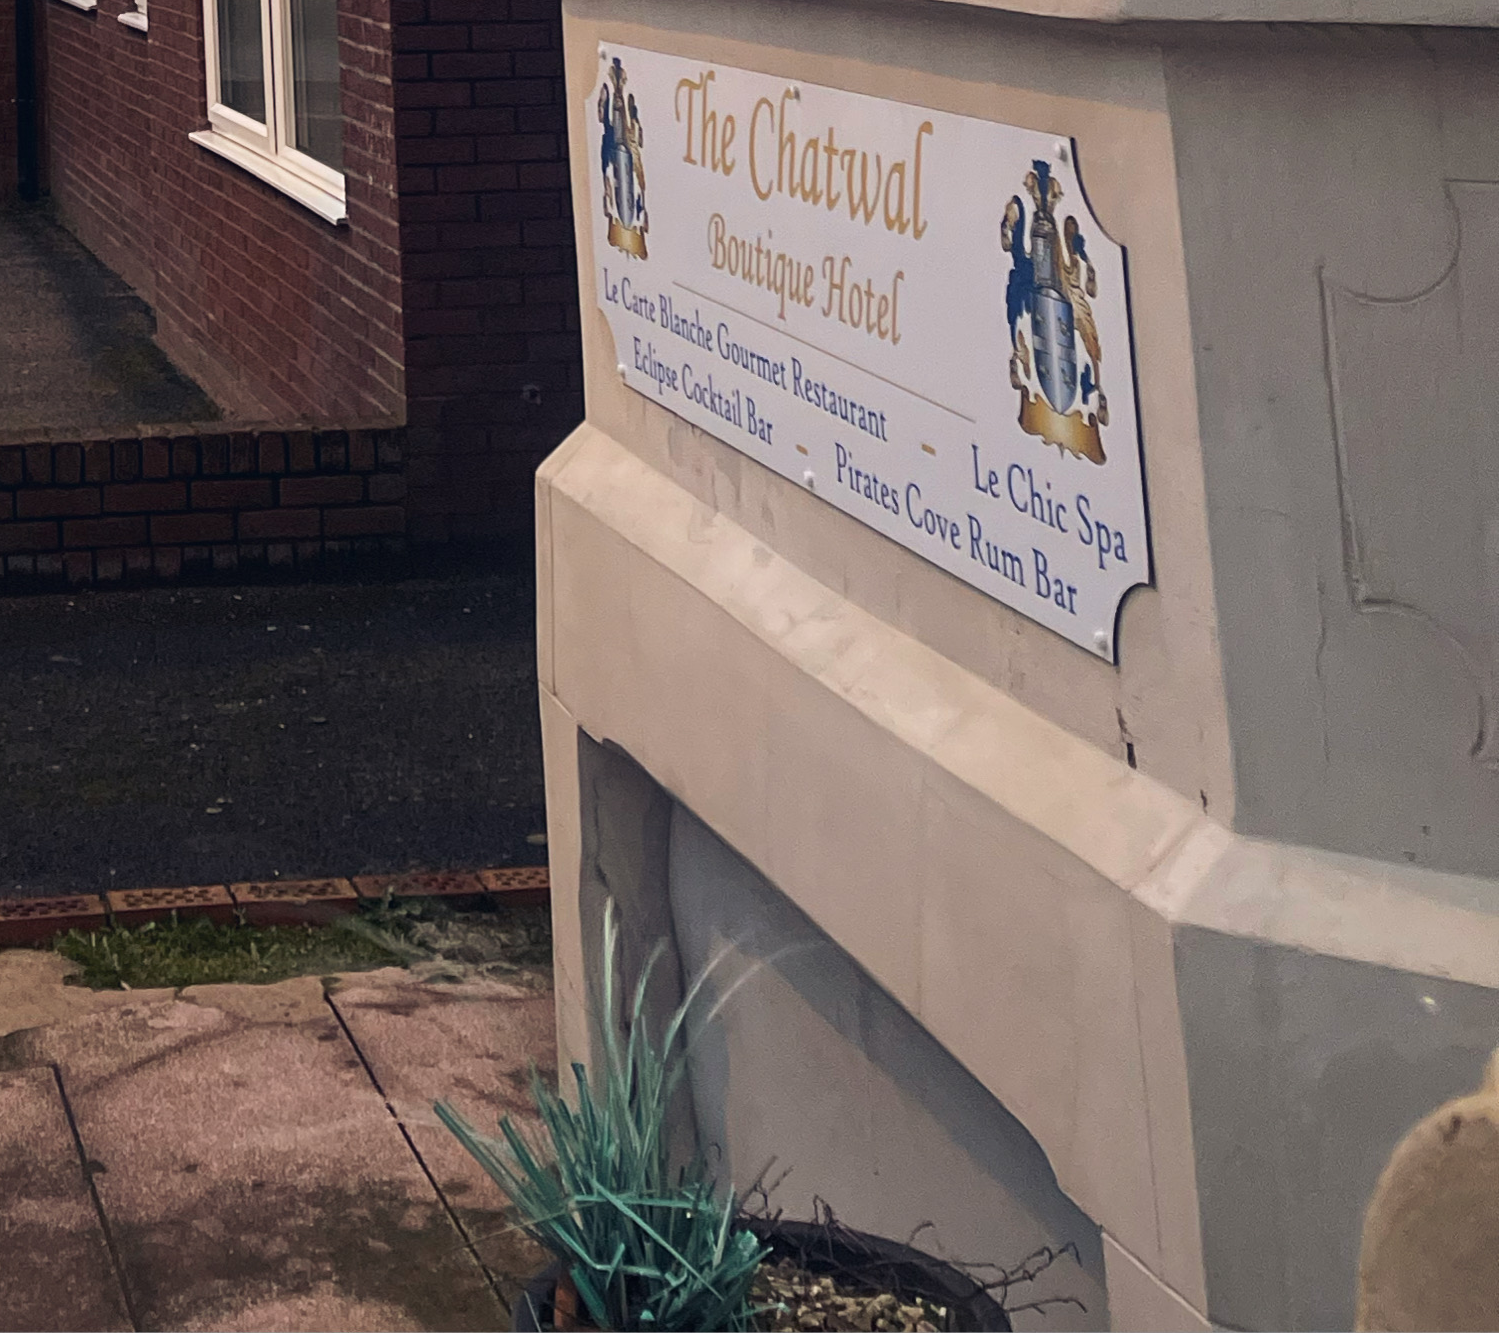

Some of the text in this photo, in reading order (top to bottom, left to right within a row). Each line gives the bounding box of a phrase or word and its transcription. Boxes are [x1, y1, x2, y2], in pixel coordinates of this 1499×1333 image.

[675, 70, 933, 240] The Chatwal
[707, 212, 904, 345] Boutique Hotel
[603, 268, 619, 304] Le
[621, 277, 656, 323] Carte
[659, 293, 714, 352] Blanche
[717, 323, 787, 391] Gourmet
[791, 357, 888, 442] Restaurant
[972, 443, 1000, 499] Le
[1008, 463, 1068, 533] Chic
[1076, 494, 1128, 570] Spa
[633, 336, 678, 395] Eclipse
[682, 364, 743, 429] Cocktail
[746, 396, 773, 445] Bar
[835, 442, 900, 515] Pirates
[906, 483, 961, 550] Cove
[967, 513, 1026, 587] Rum
[1032, 548, 1077, 616] Bar
